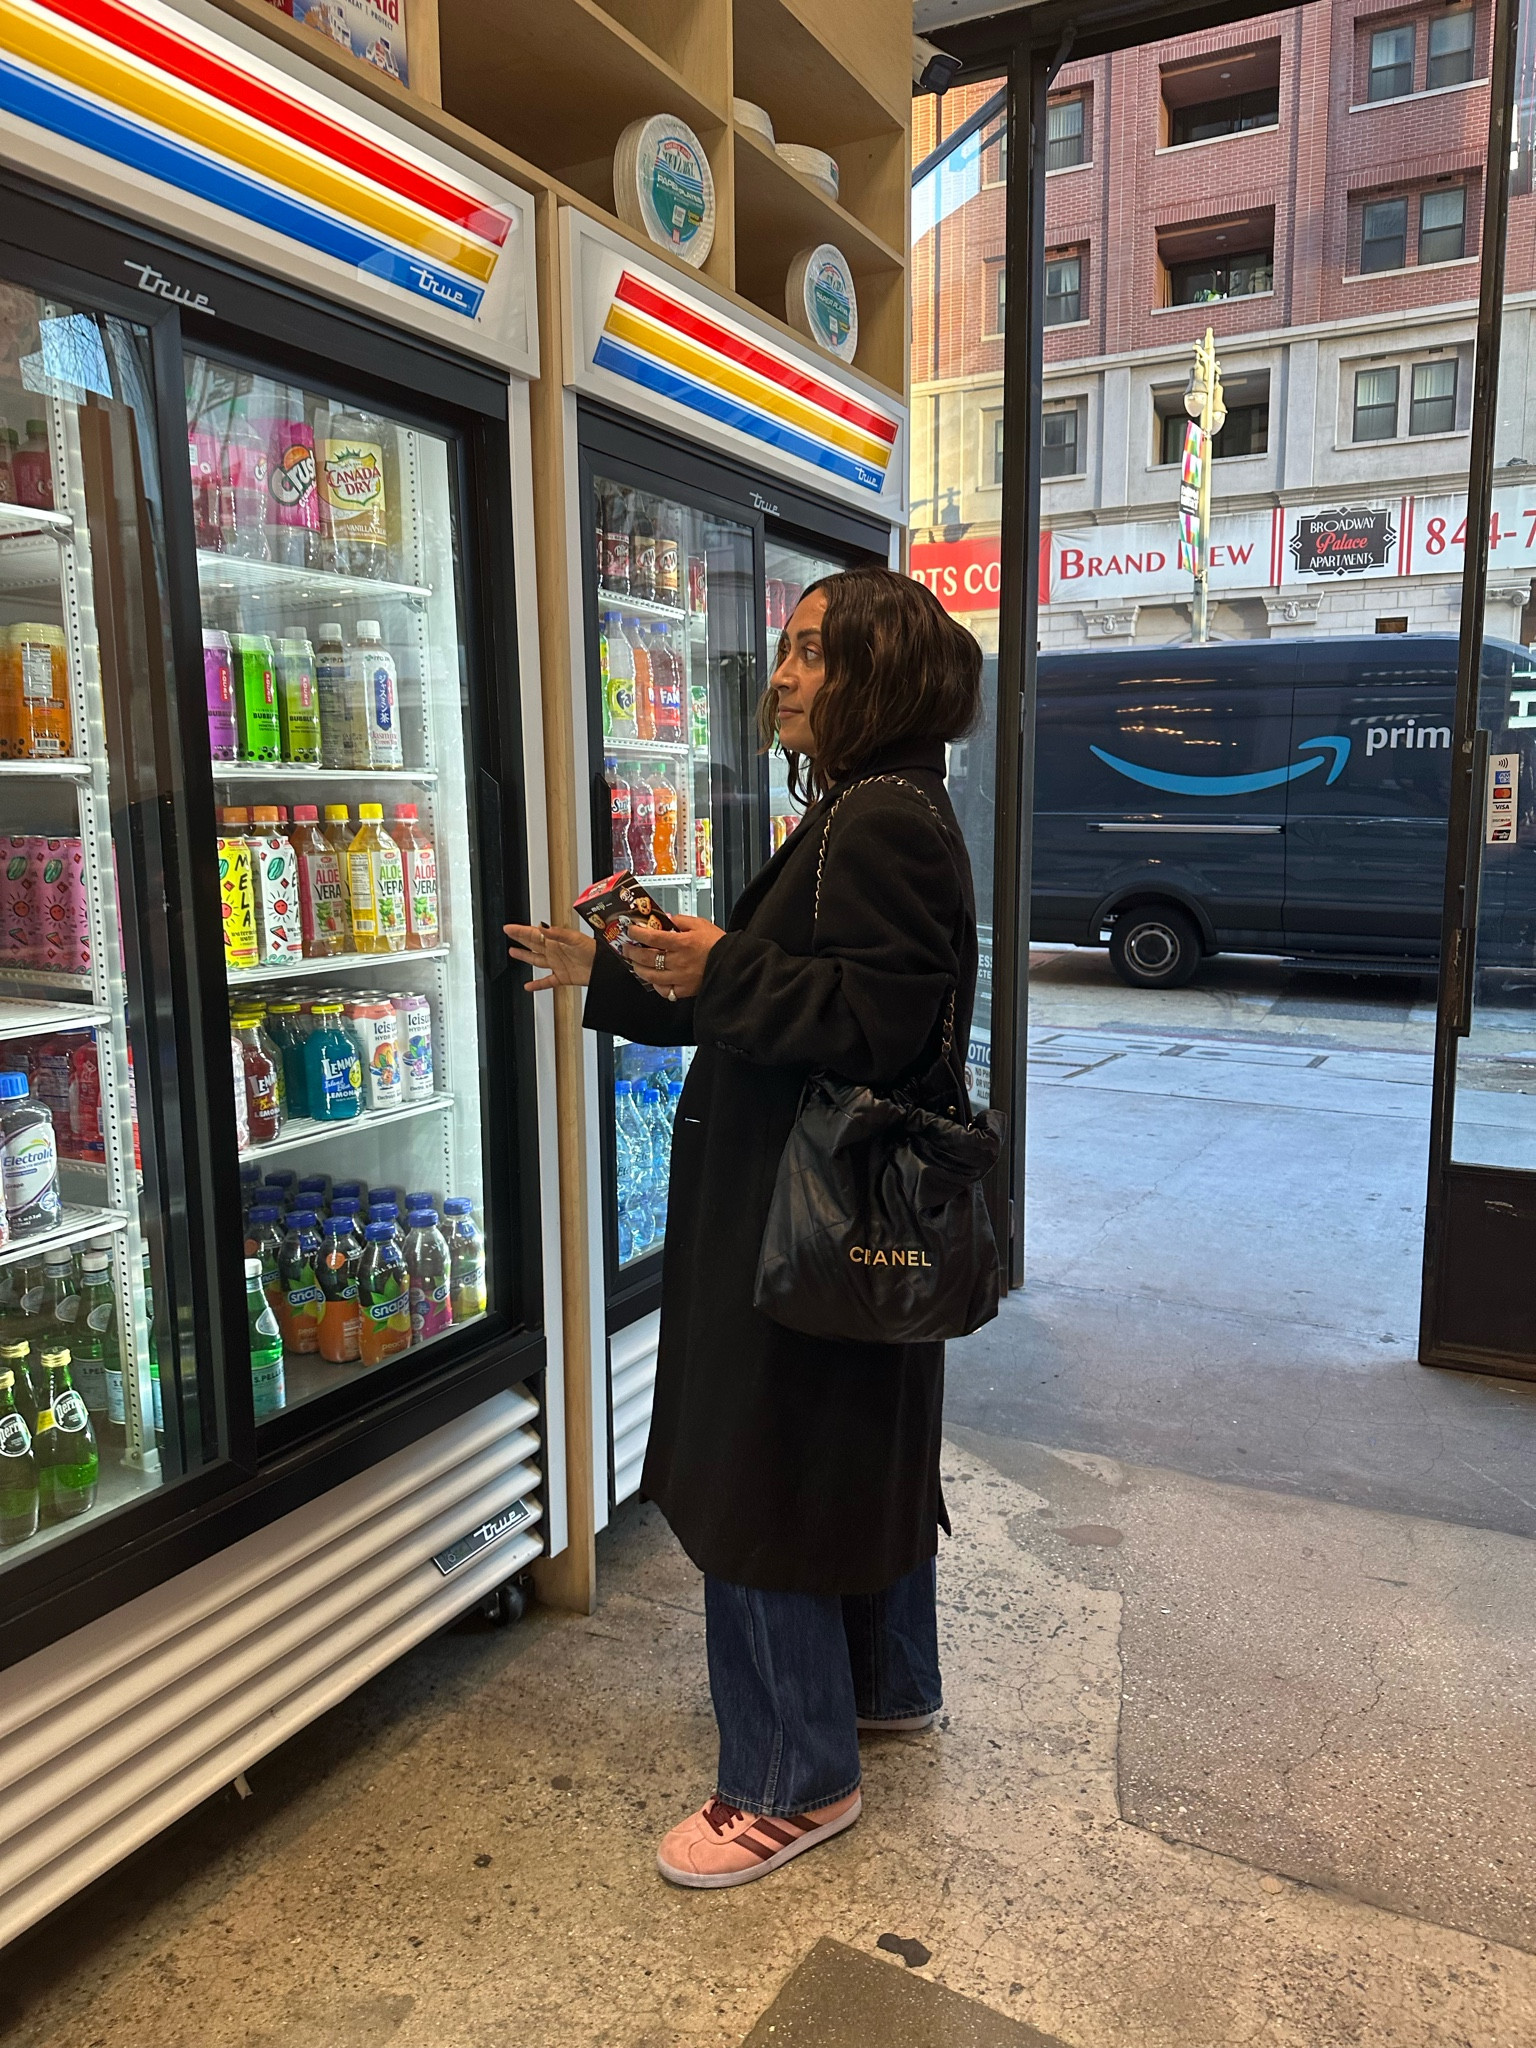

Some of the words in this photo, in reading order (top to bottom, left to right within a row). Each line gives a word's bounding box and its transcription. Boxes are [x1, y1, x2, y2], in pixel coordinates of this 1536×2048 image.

[124, 260, 216, 315] true
[409, 266, 470, 308] true
[326, 466, 382, 489] CANADA
[855, 467, 878, 487] true
[345, 481, 372, 496] DRY
[749, 491, 780, 517] true
[1310, 517, 1376, 534] BROADWAY
[1316, 532, 1368, 554] Palace
[1060, 548, 1166, 581] BRAND
[1309, 552, 1374, 569] APARTMENTS
[378, 674, 390, 724] ジャスミン茶
[660, 687, 680, 705] FAN
[1366, 719, 1452, 756] prim
[637, 803, 652, 817] Cru
[316, 868, 341, 885] ALOE
[380, 864, 402, 880] ALOE
[415, 864, 437, 880] ALOE
[313, 883, 342, 900] VERA
[412, 880, 438, 896] VERA
[3, 1147, 53, 1167] Electrolit
[473, 1511, 522, 1541] true
